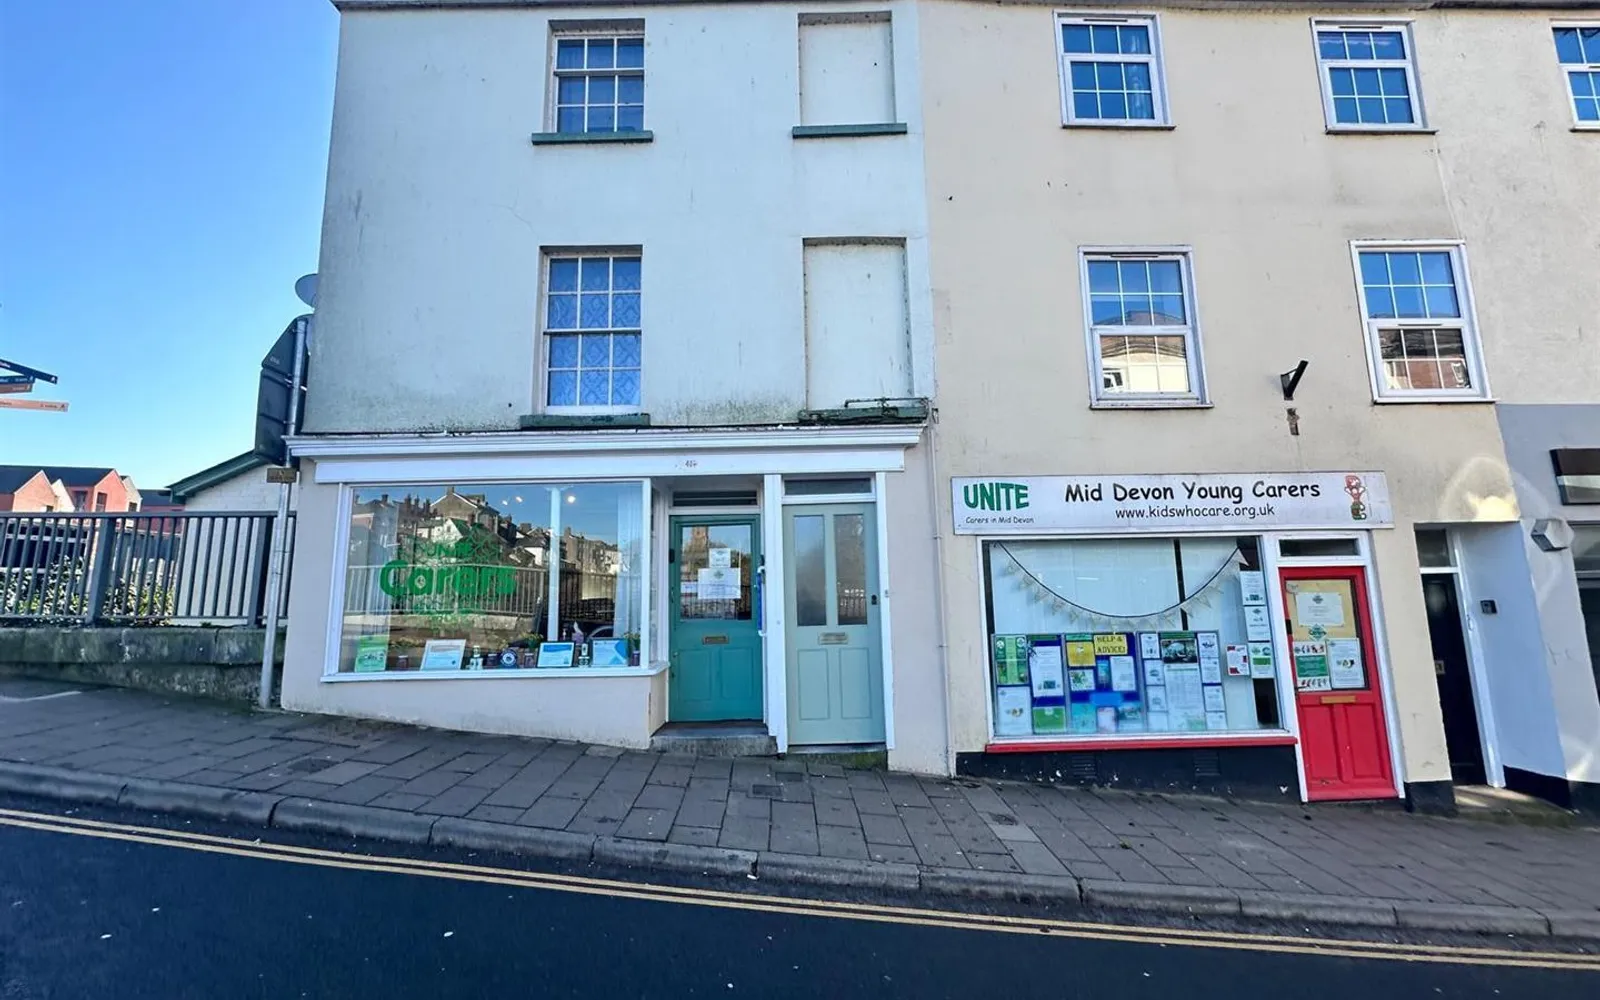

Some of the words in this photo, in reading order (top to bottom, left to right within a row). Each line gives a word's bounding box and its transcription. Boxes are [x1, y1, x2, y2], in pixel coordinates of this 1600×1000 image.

[963, 482, 1029, 511] UNITE
[1065, 482, 1103, 502] Mid
[1113, 482, 1174, 501] Devon
[1181, 480, 1243, 504] Young
[1252, 479, 1321, 498] Carers
[965, 516, 989, 524] Carers
[998, 516, 1012, 524] Mid
[1013, 516, 1034, 524] Devon
[1115, 502, 1276, 519] www.kidswhocare.org.uk
[380, 560, 516, 597] Carers
[1096, 635, 1115, 643] HELP
